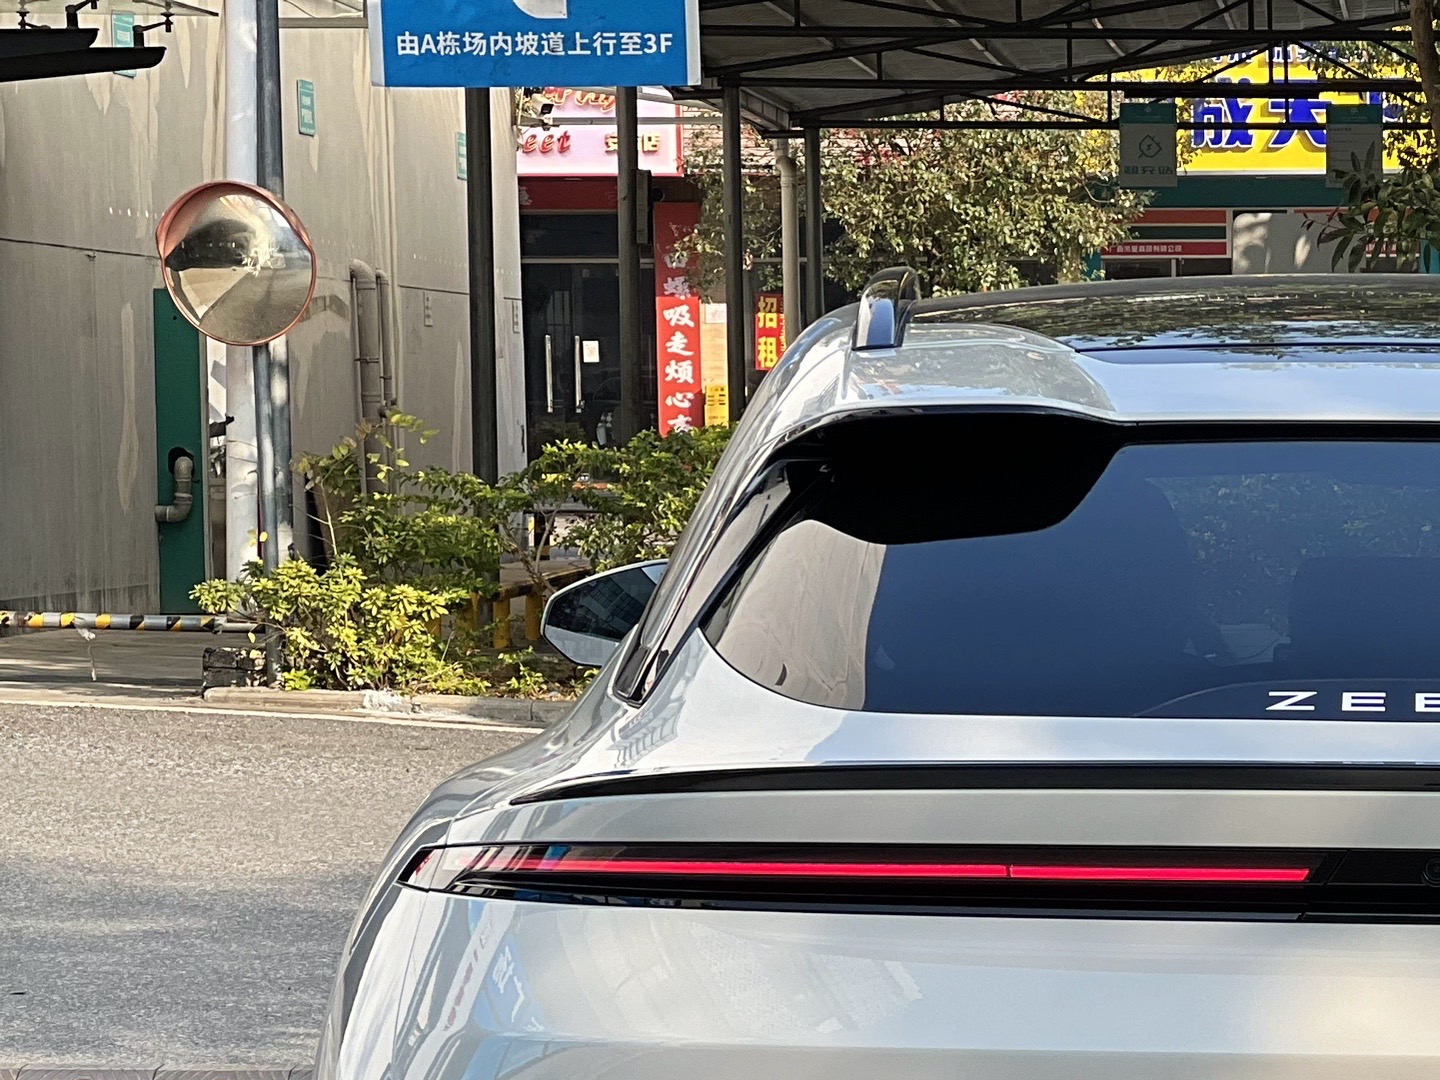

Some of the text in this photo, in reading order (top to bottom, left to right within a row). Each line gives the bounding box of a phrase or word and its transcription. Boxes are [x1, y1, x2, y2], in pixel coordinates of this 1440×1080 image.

[396, 31, 673, 56] 由A栋场内坡道上行至3F
[758, 296, 778, 368] 招租
